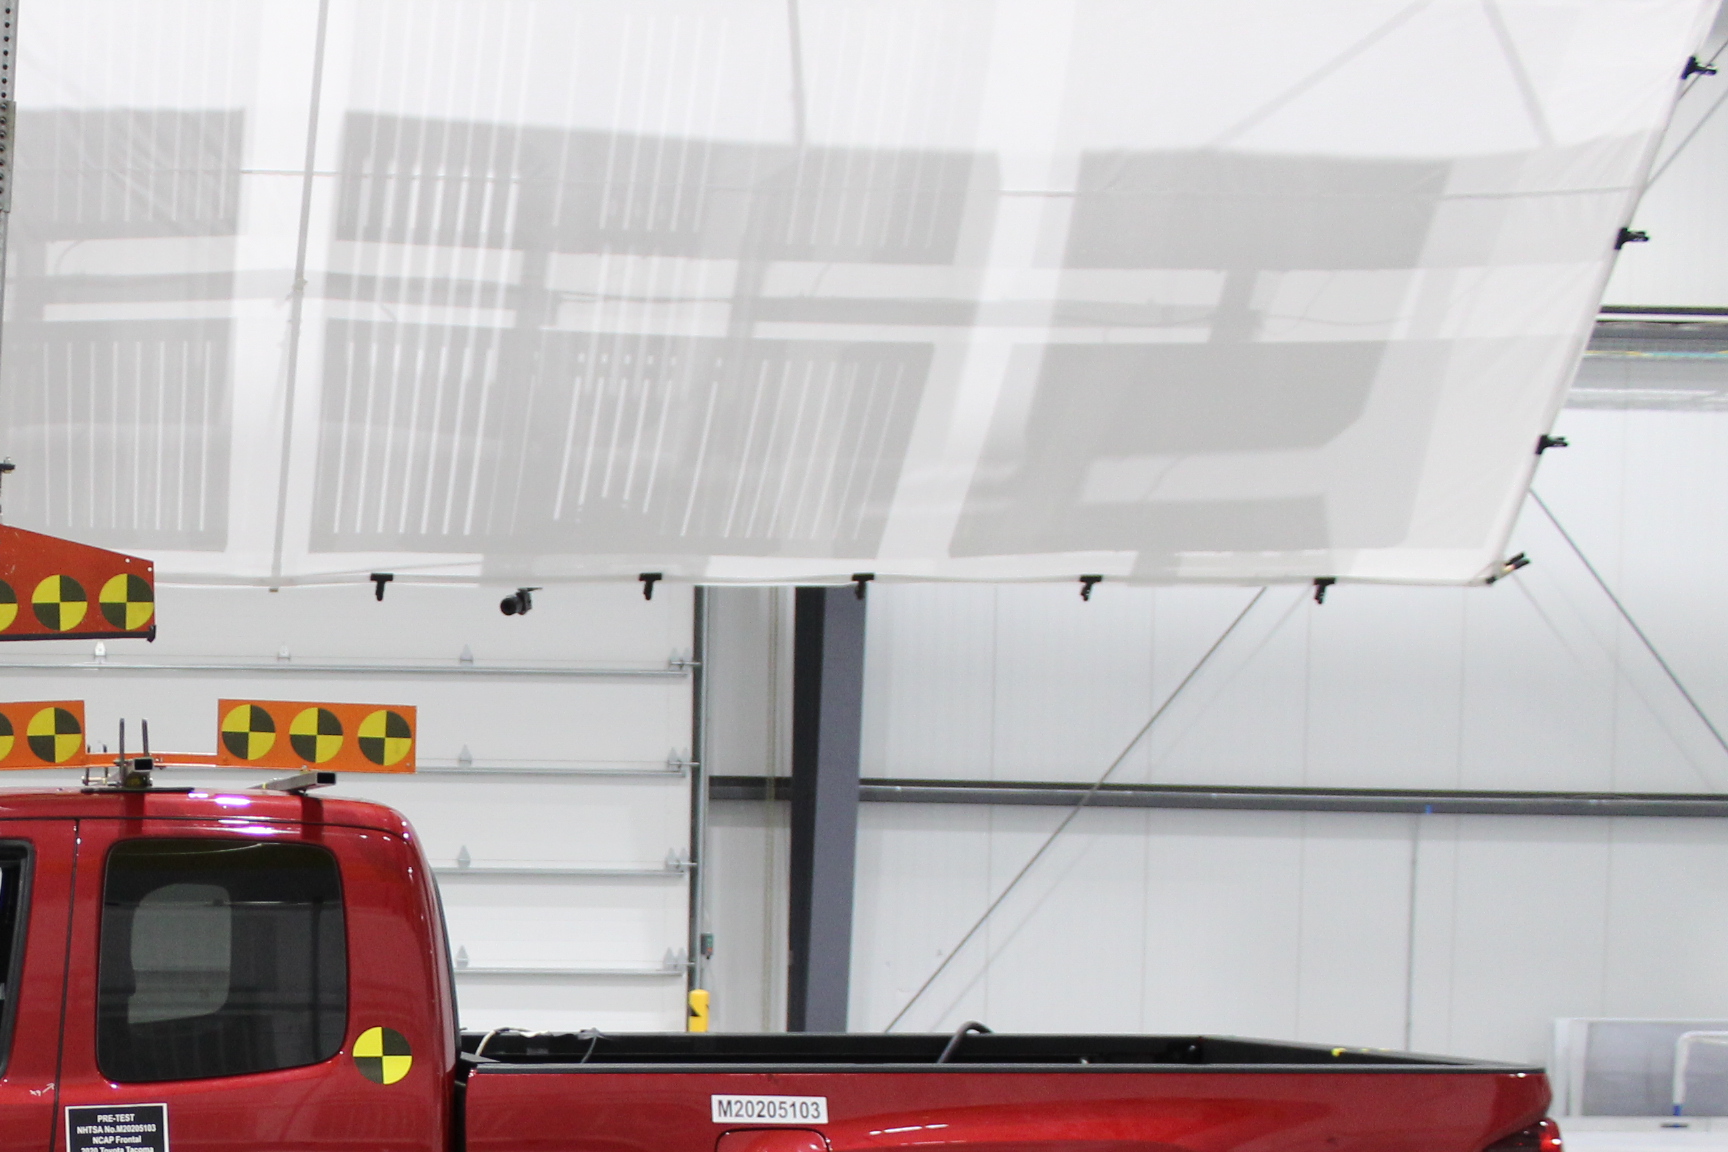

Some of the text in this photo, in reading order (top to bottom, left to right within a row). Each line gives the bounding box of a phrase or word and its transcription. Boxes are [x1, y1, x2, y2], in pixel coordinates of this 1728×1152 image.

[717, 1099, 821, 1119] M20205103
[97, 1113, 135, 1123] PRE-TEST
[76, 1126, 103, 1134] NHTSA
[92, 1135, 142, 1144] NCAP Frontal
